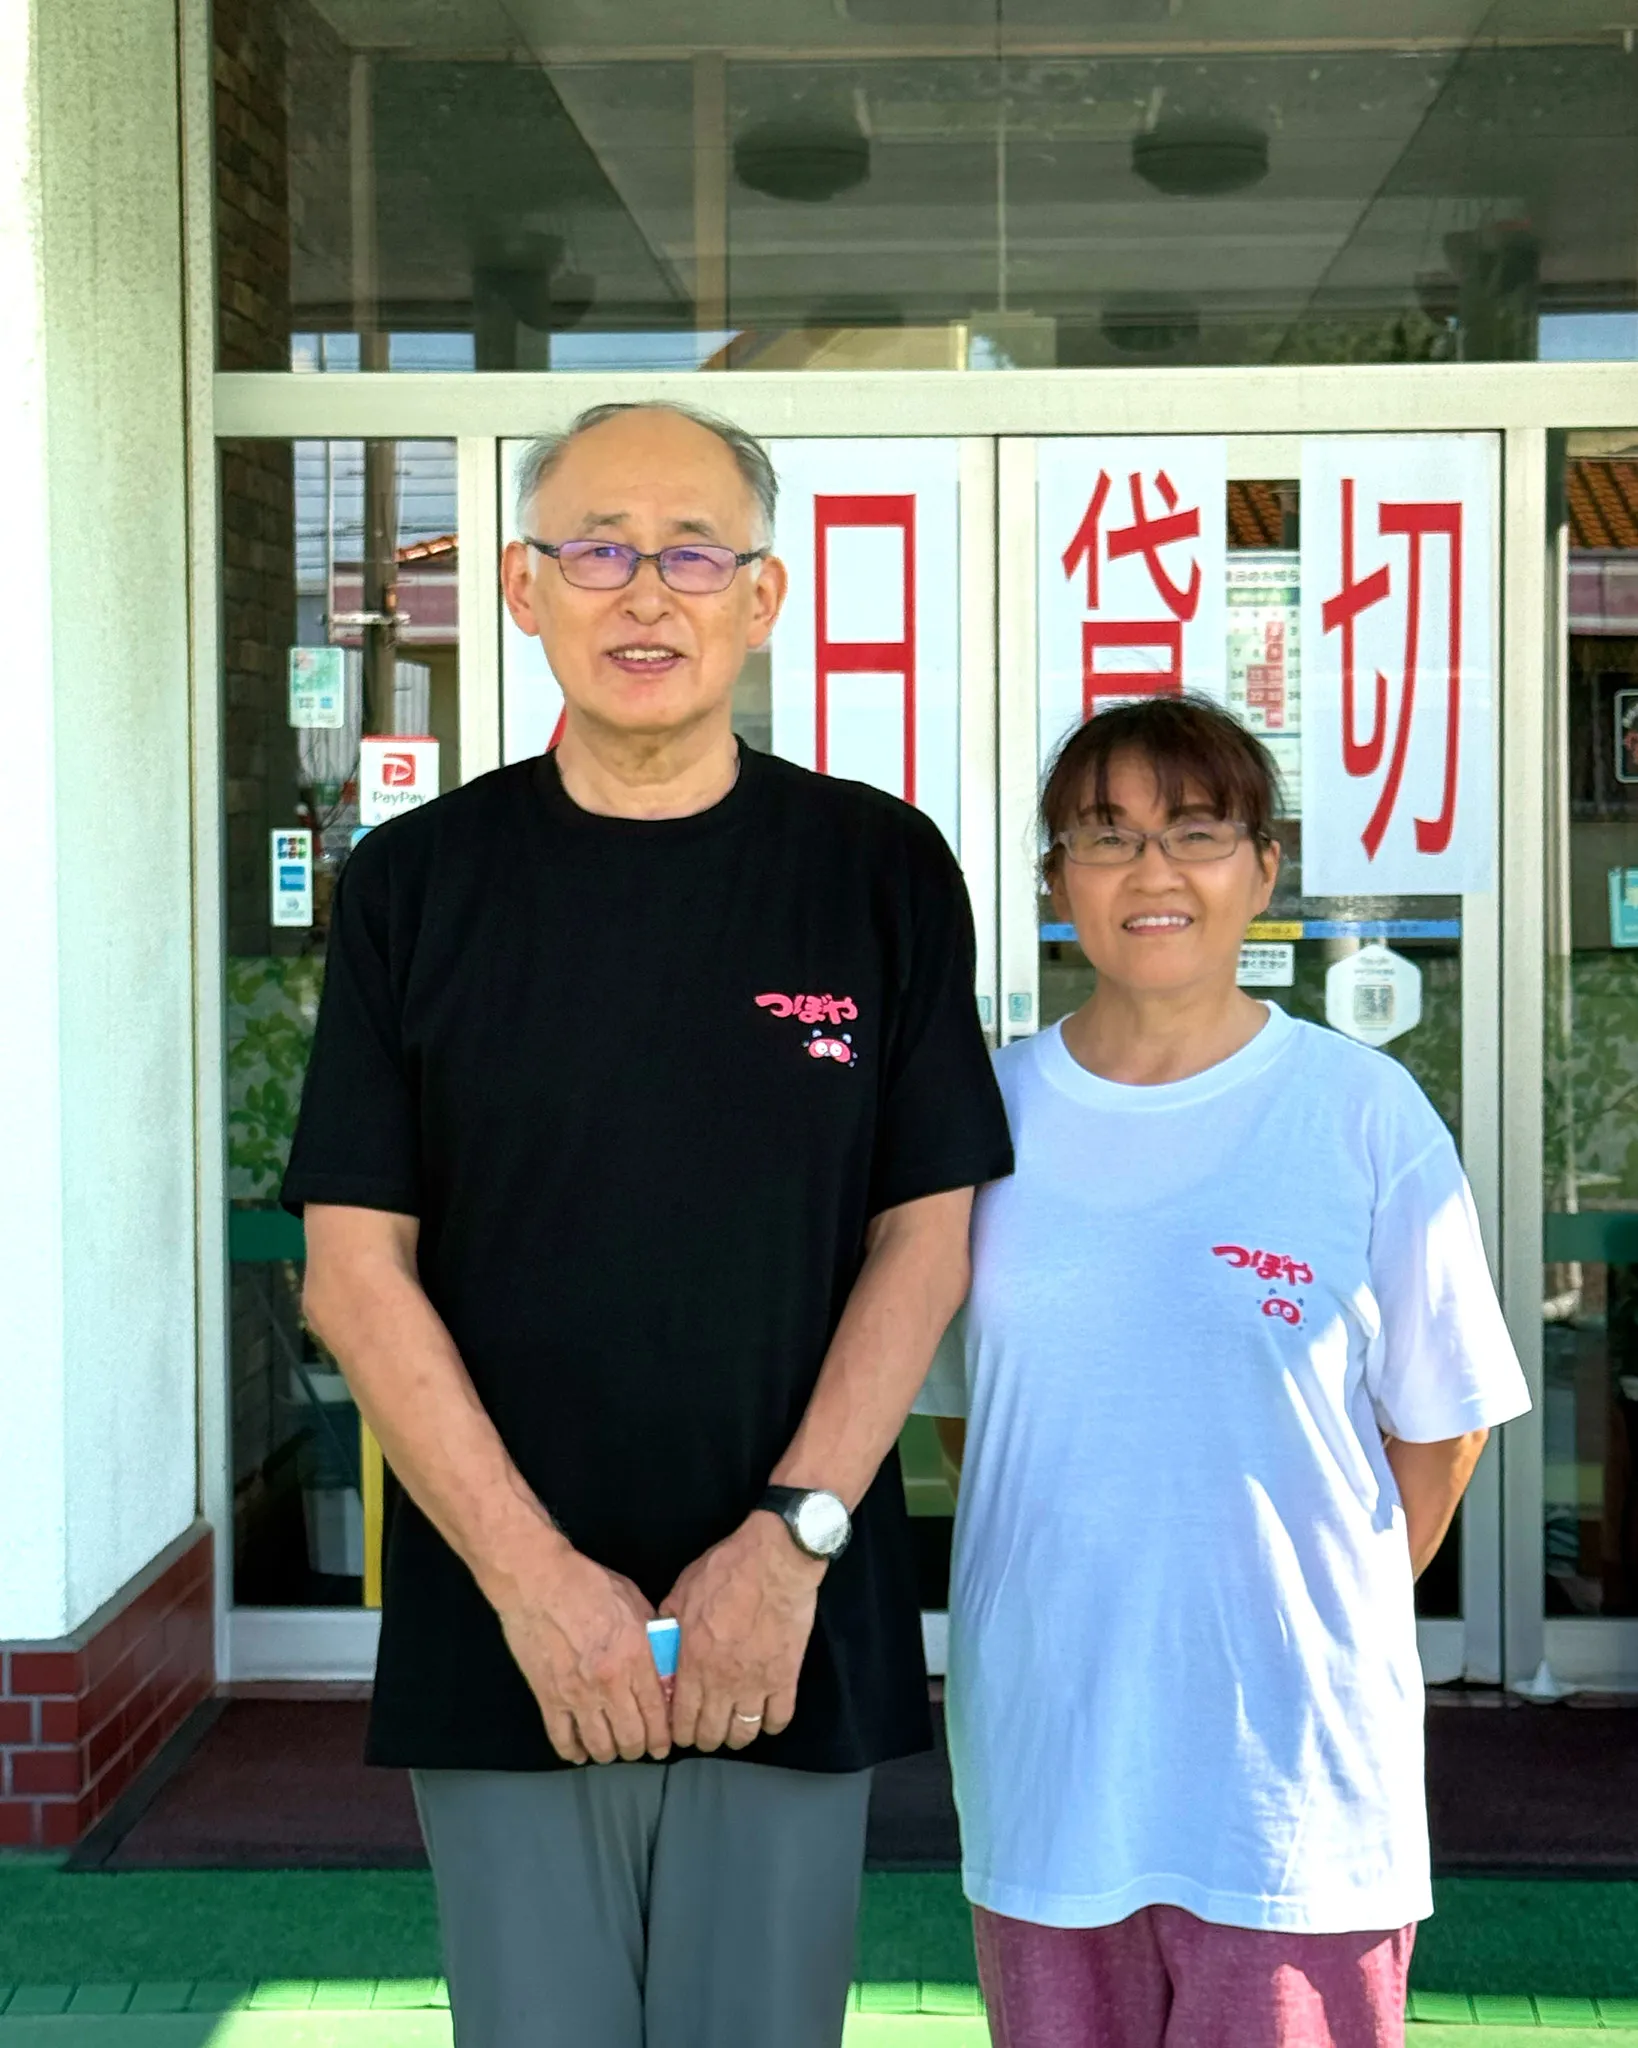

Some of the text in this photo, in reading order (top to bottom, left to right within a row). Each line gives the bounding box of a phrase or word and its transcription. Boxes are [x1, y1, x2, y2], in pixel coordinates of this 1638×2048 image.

[372, 791, 426, 805] PayPay
[755, 993, 858, 1025] つぼや
[1212, 1246, 1313, 1286] つぼや
